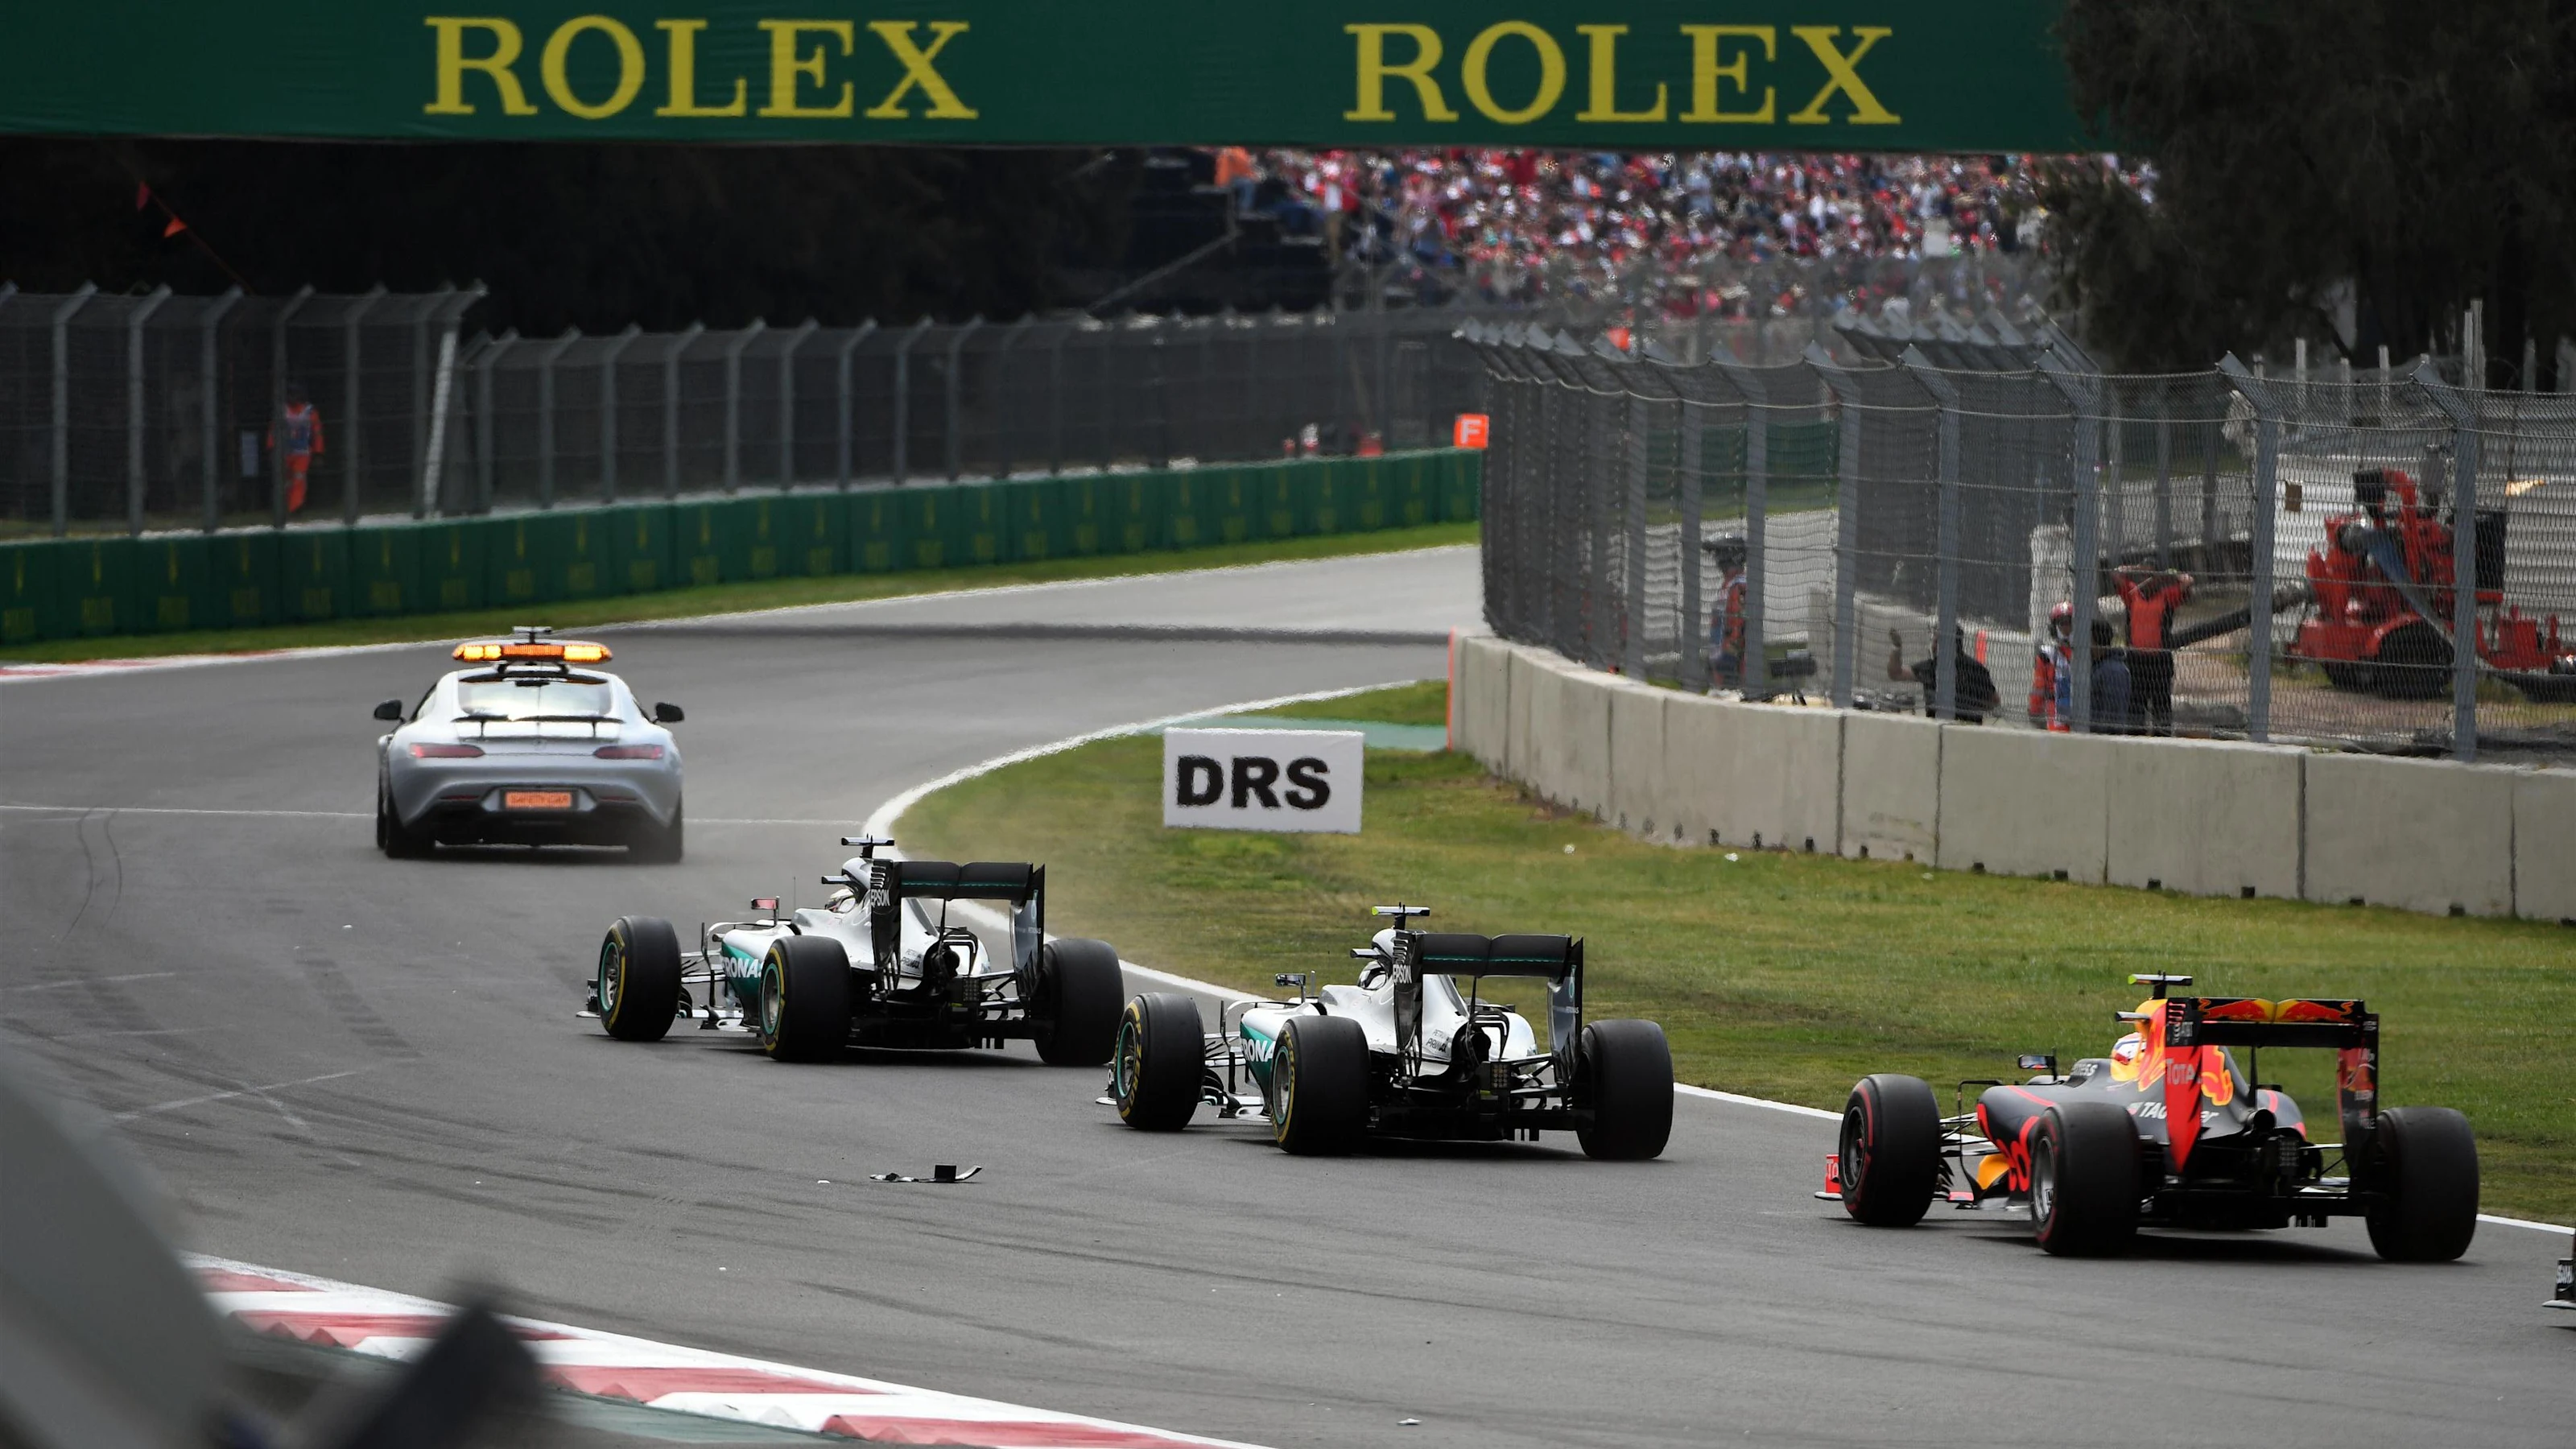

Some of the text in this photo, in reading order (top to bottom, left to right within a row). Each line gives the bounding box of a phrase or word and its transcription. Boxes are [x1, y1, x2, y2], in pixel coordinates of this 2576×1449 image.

[423, 15, 979, 119] ROLEX
[1344, 20, 1901, 125] ROLEX
[1461, 419, 1480, 444] F
[1177, 754, 1331, 810] DRS
[870, 889, 890, 907] EPSON
[1393, 964, 1412, 985] EPSON
